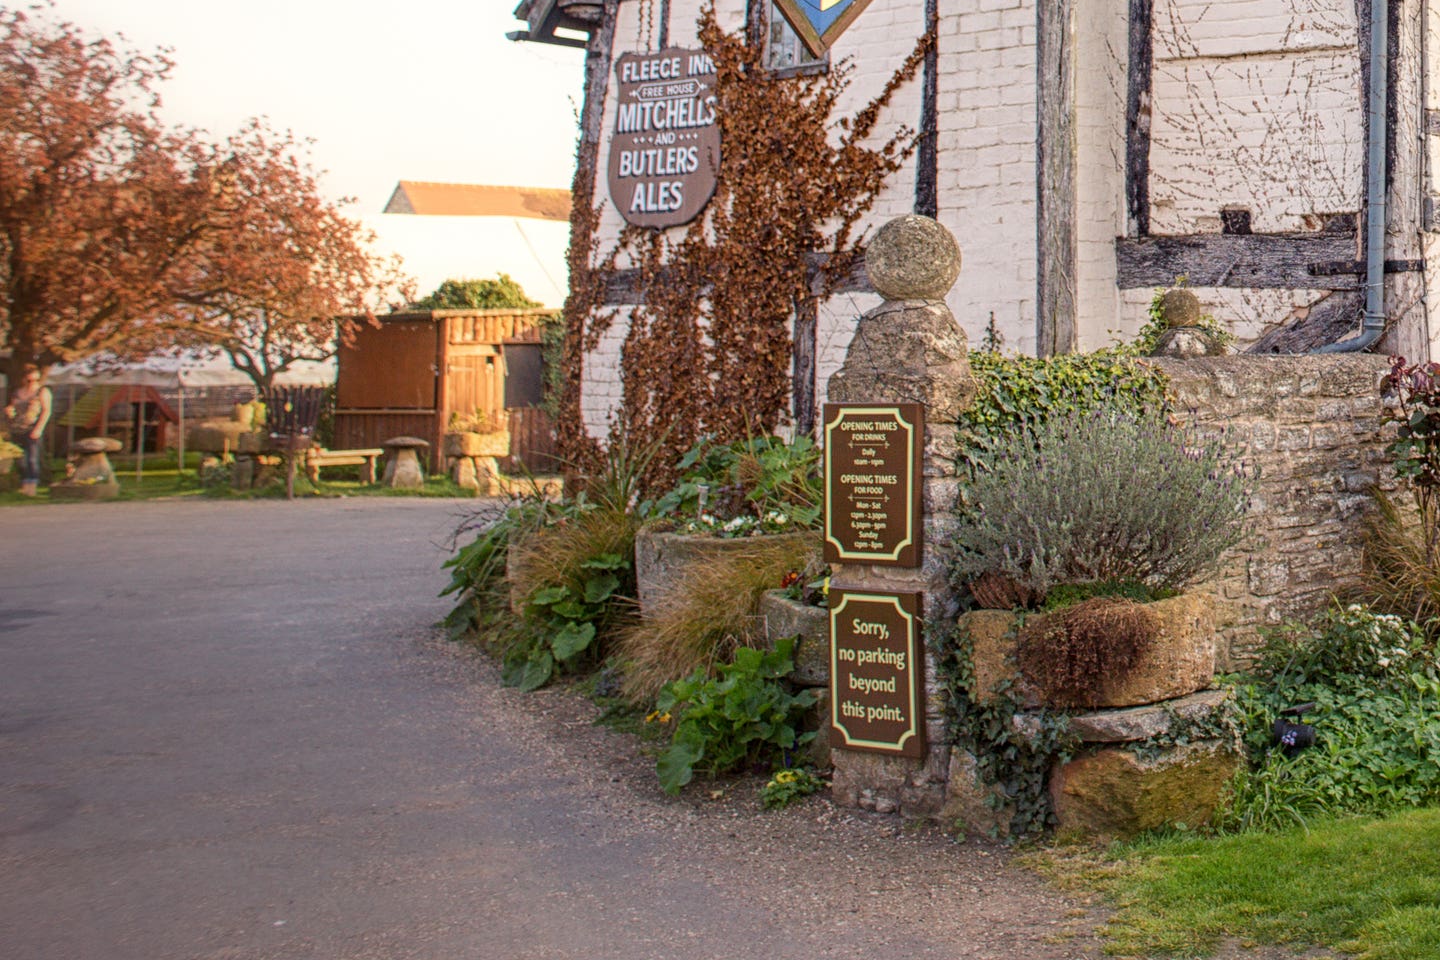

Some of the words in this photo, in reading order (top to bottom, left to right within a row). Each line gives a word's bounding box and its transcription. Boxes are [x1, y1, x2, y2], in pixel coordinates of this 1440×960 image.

[621, 56, 681, 82] FLEECE
[641, 86, 664, 98] FREE
[666, 83, 695, 95] HOUSE
[617, 96, 717, 133] MITCHELLS
[654, 132, 677, 146] AND
[618, 146, 699, 177] BUTLERS
[630, 181, 684, 212] ALES
[841, 421, 874, 431] OPENING
[874, 421, 898, 431] TIMES
[852, 433, 864, 441] FOR
[865, 433, 886, 441] DRINKS
[840, 474, 873, 484] OPENING
[874, 475, 898, 484] TIMES
[854, 486, 866, 494] FOR
[867, 486, 883, 494] FOOD
[858, 531, 878, 540] Sunday
[852, 618, 889, 639] Sorry,
[839, 647, 855, 661] no
[857, 646, 905, 670] parking
[849, 672, 896, 694] beyond
[842, 701, 865, 718] this
[867, 704, 905, 723] point.
